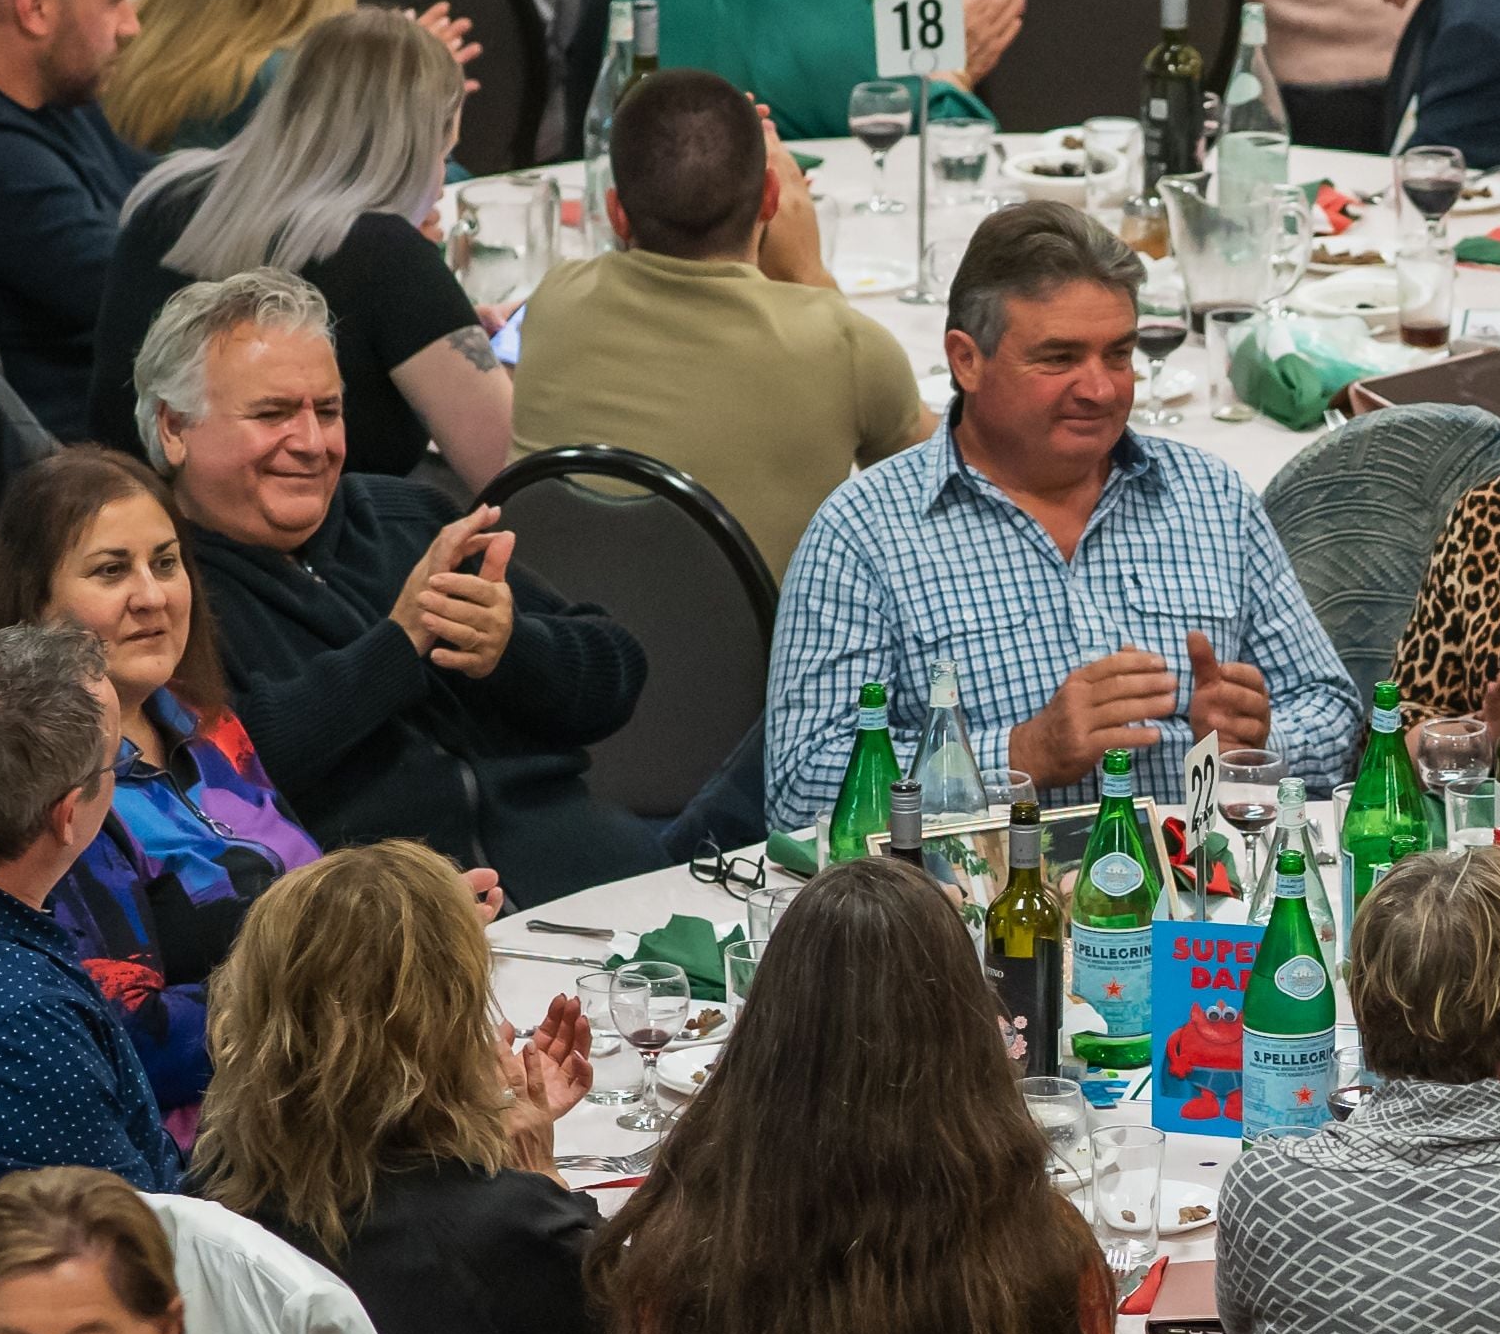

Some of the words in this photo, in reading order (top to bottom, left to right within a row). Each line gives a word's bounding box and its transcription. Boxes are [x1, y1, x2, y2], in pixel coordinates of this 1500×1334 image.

[1191, 754, 1216, 834] 22
[1073, 941, 1152, 960] .PELLEGRIN
[1172, 937, 1262, 964] SUPE
